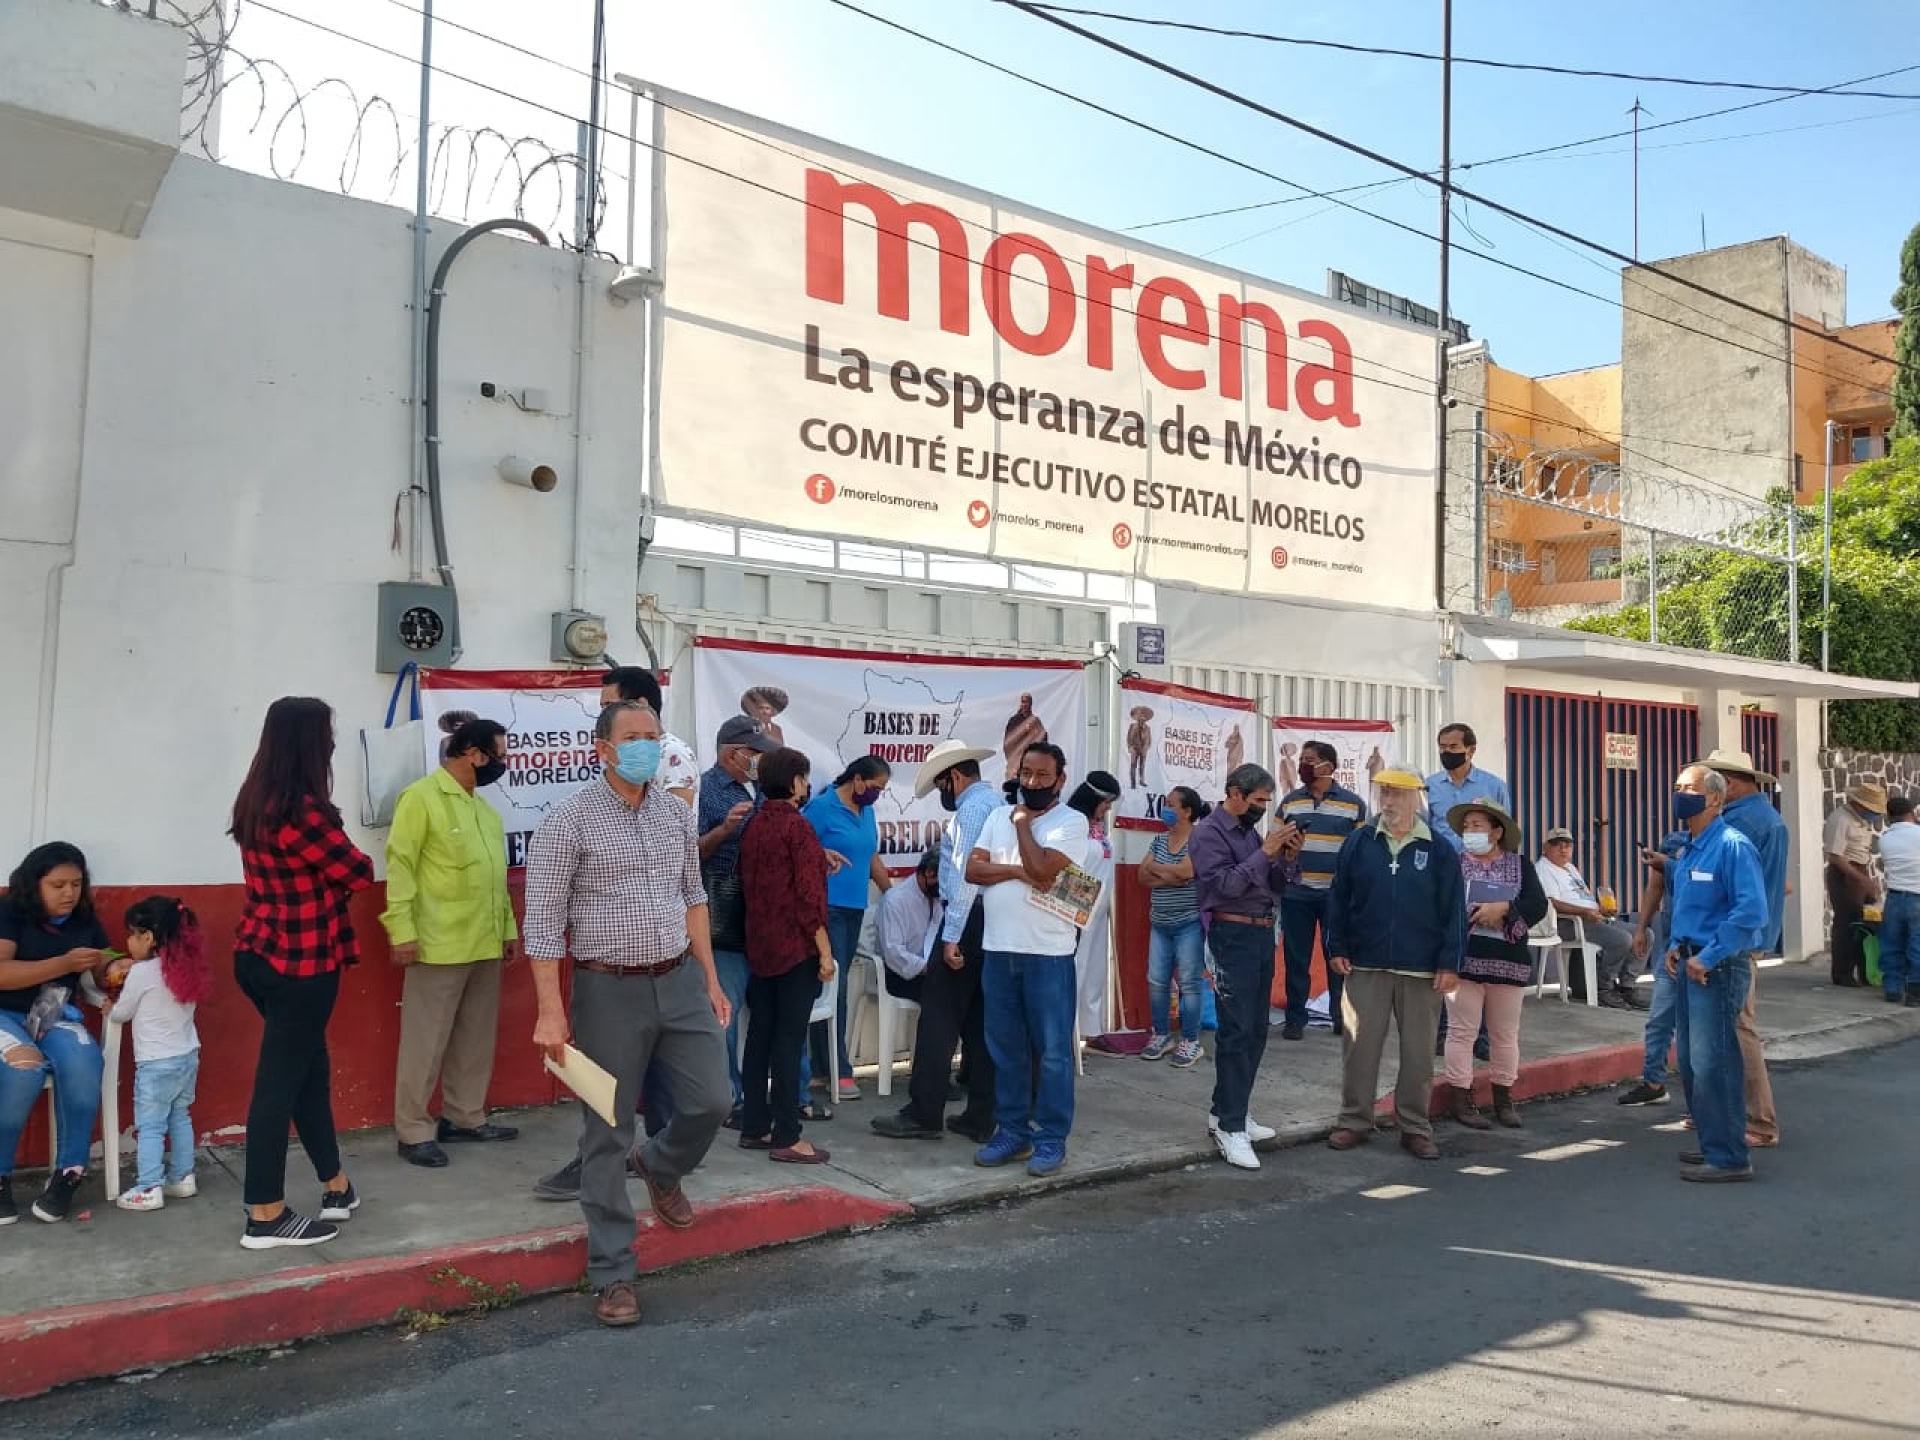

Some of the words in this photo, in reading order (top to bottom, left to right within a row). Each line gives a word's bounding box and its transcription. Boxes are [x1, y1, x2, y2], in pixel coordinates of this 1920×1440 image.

[805, 168, 1361, 428] morena
[805, 324, 873, 393] La
[890, 360, 1147, 449] esperanza
[1160, 405, 1211, 460] de
[1225, 420, 1363, 489] México
[800, 418, 946, 473] COMITÉ
[956, 446, 1126, 502] EJECUTIVO
[1133, 479, 1245, 523] ESTATAL
[1252, 499, 1365, 542] MORELOS
[838, 486, 939, 511] /morelosmorena
[992, 510, 1084, 534] /morelos_morena
[1135, 533, 1249, 559] www.morenamorelos.org
[864, 712, 914, 735] BASES
[918, 713, 940, 736] DE
[506, 731, 571, 749] BASES
[1165, 727, 1198, 743] BASES
[1201, 733, 1213, 746] DE
[506, 749, 600, 770] morena
[1165, 742, 1212, 759] morena
[1165, 754, 1212, 771] MORELOS
[509, 765, 600, 787] MORELOS
